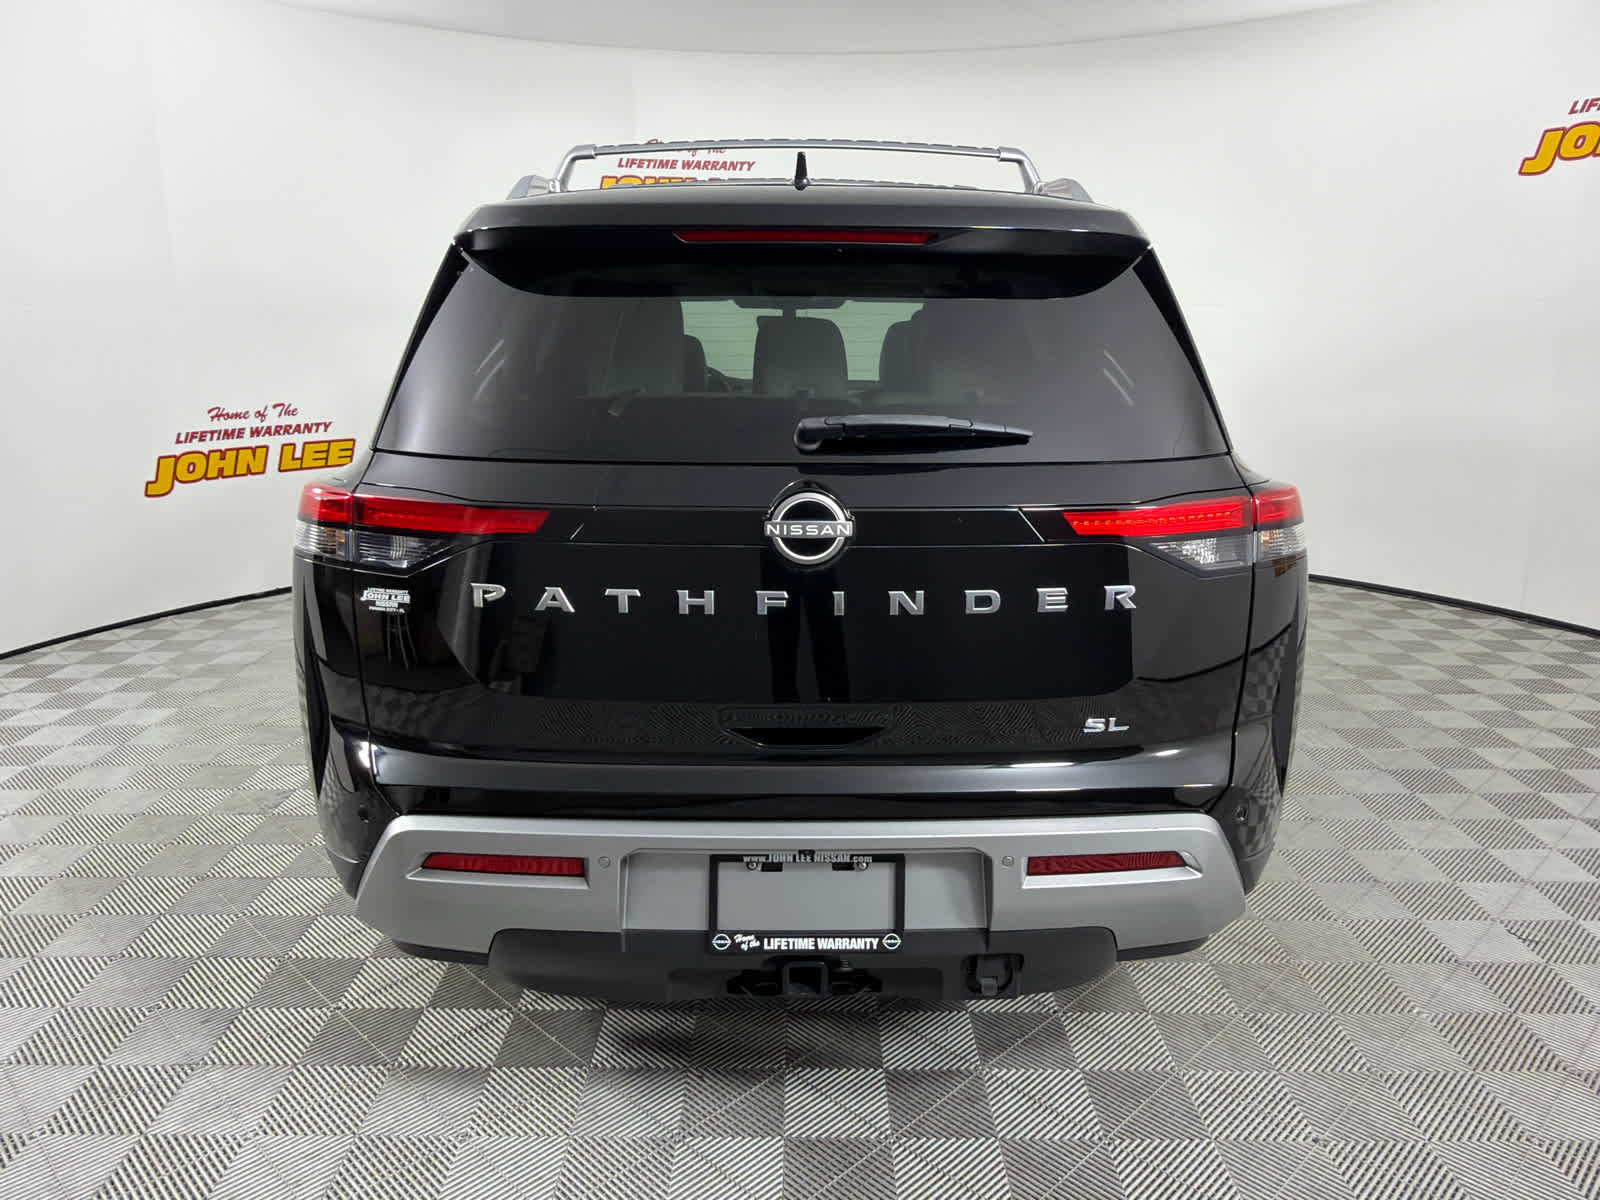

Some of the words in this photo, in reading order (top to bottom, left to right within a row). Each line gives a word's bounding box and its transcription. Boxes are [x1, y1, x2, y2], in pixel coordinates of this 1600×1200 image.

[1518, 121, 1600, 176] JO
[617, 158, 678, 170] LIFETIME
[681, 159, 755, 172] WARRANTY
[207, 406, 250, 422] Home
[254, 405, 268, 422] of
[272, 403, 298, 418] The
[175, 428, 246, 444] LIFETIME
[250, 421, 333, 438] WARRANTY
[144, 445, 269, 497] JOHN
[278, 438, 356, 472] LEE
[766, 524, 850, 536] NISSAN
[360, 590, 389, 602] JOHN
[390, 592, 410, 604] LEE
[470, 582, 1138, 616] PATHFINDER
[1083, 717, 1130, 733] SL
[763, 938, 815, 950] LIFETIME
[817, 938, 879, 950] WARRANTY
